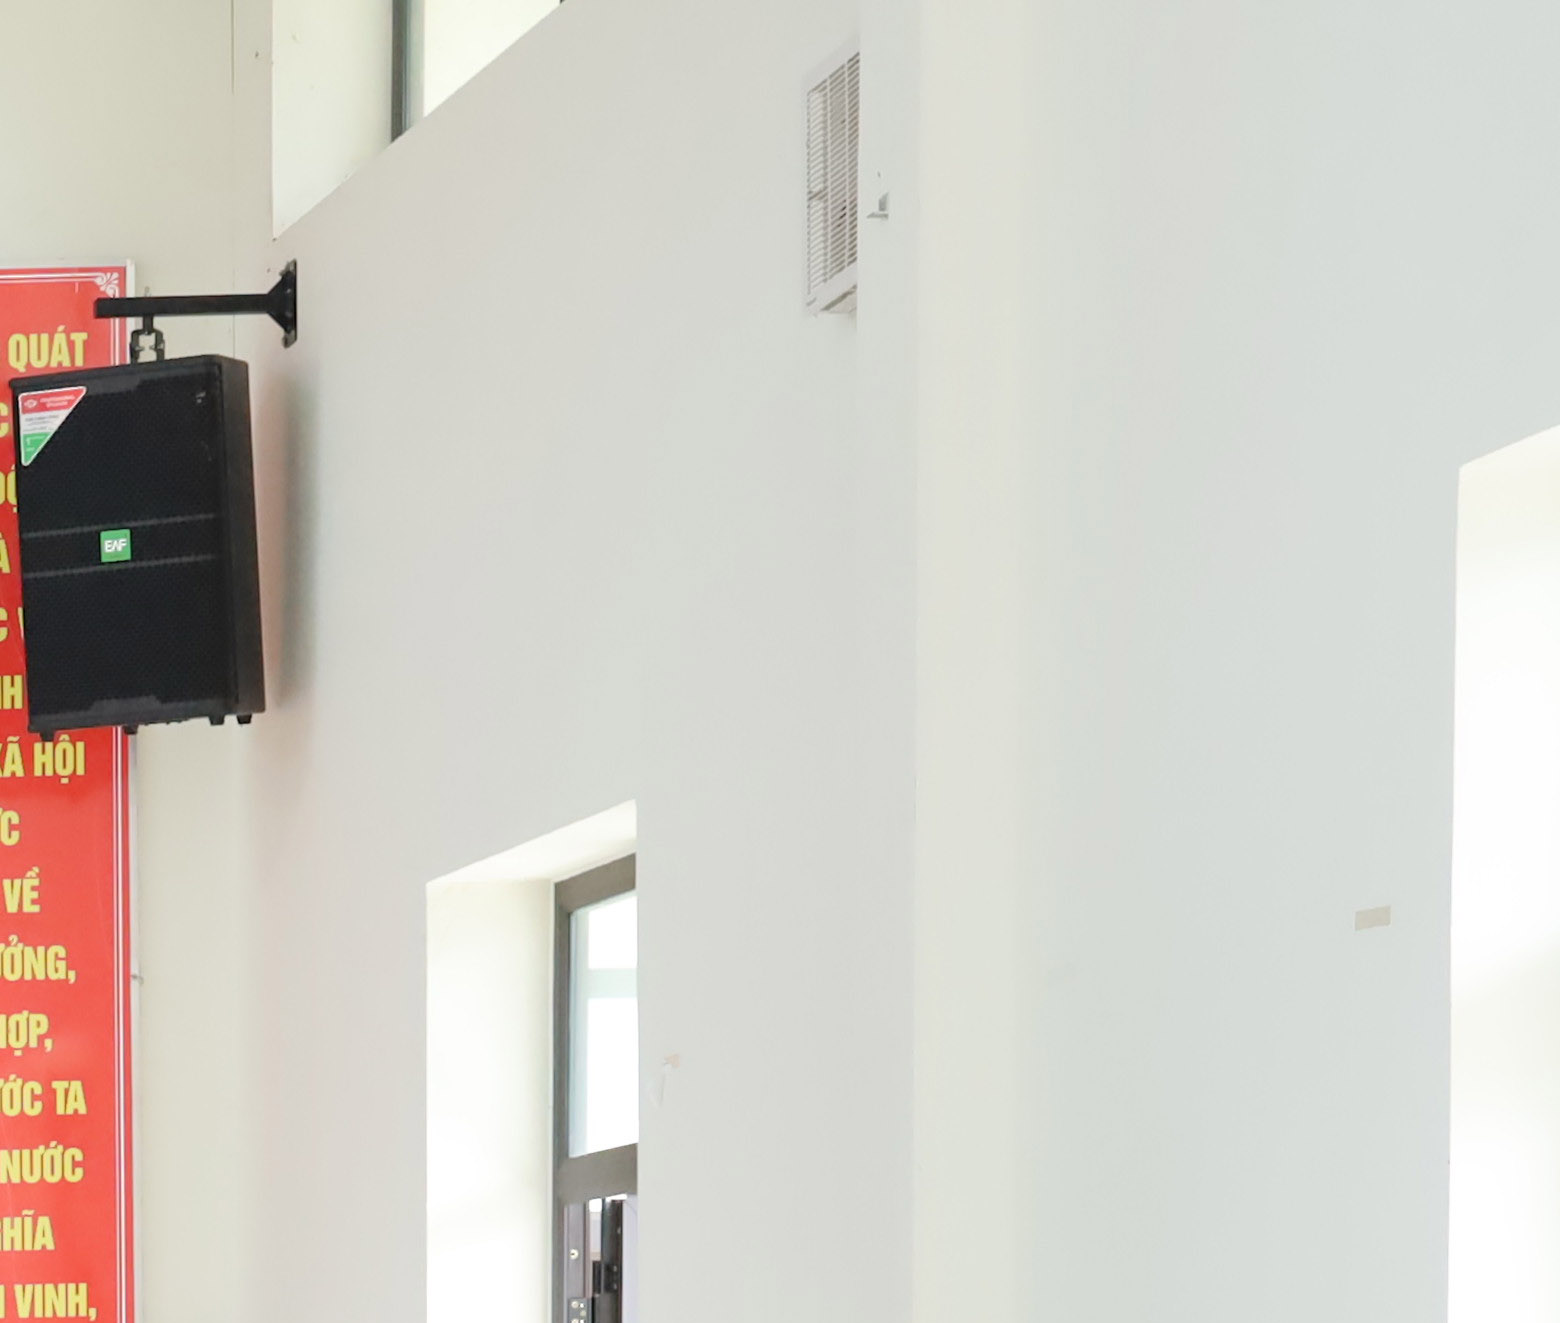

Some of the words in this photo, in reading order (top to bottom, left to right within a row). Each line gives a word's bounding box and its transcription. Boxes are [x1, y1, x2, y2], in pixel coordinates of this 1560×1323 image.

[8, 327, 88, 372] QUÁT
[32, 734, 86, 783] HỘI
[2, 867, 42, 913] VỀ
[13, 1283, 98, 1320] VINH,
